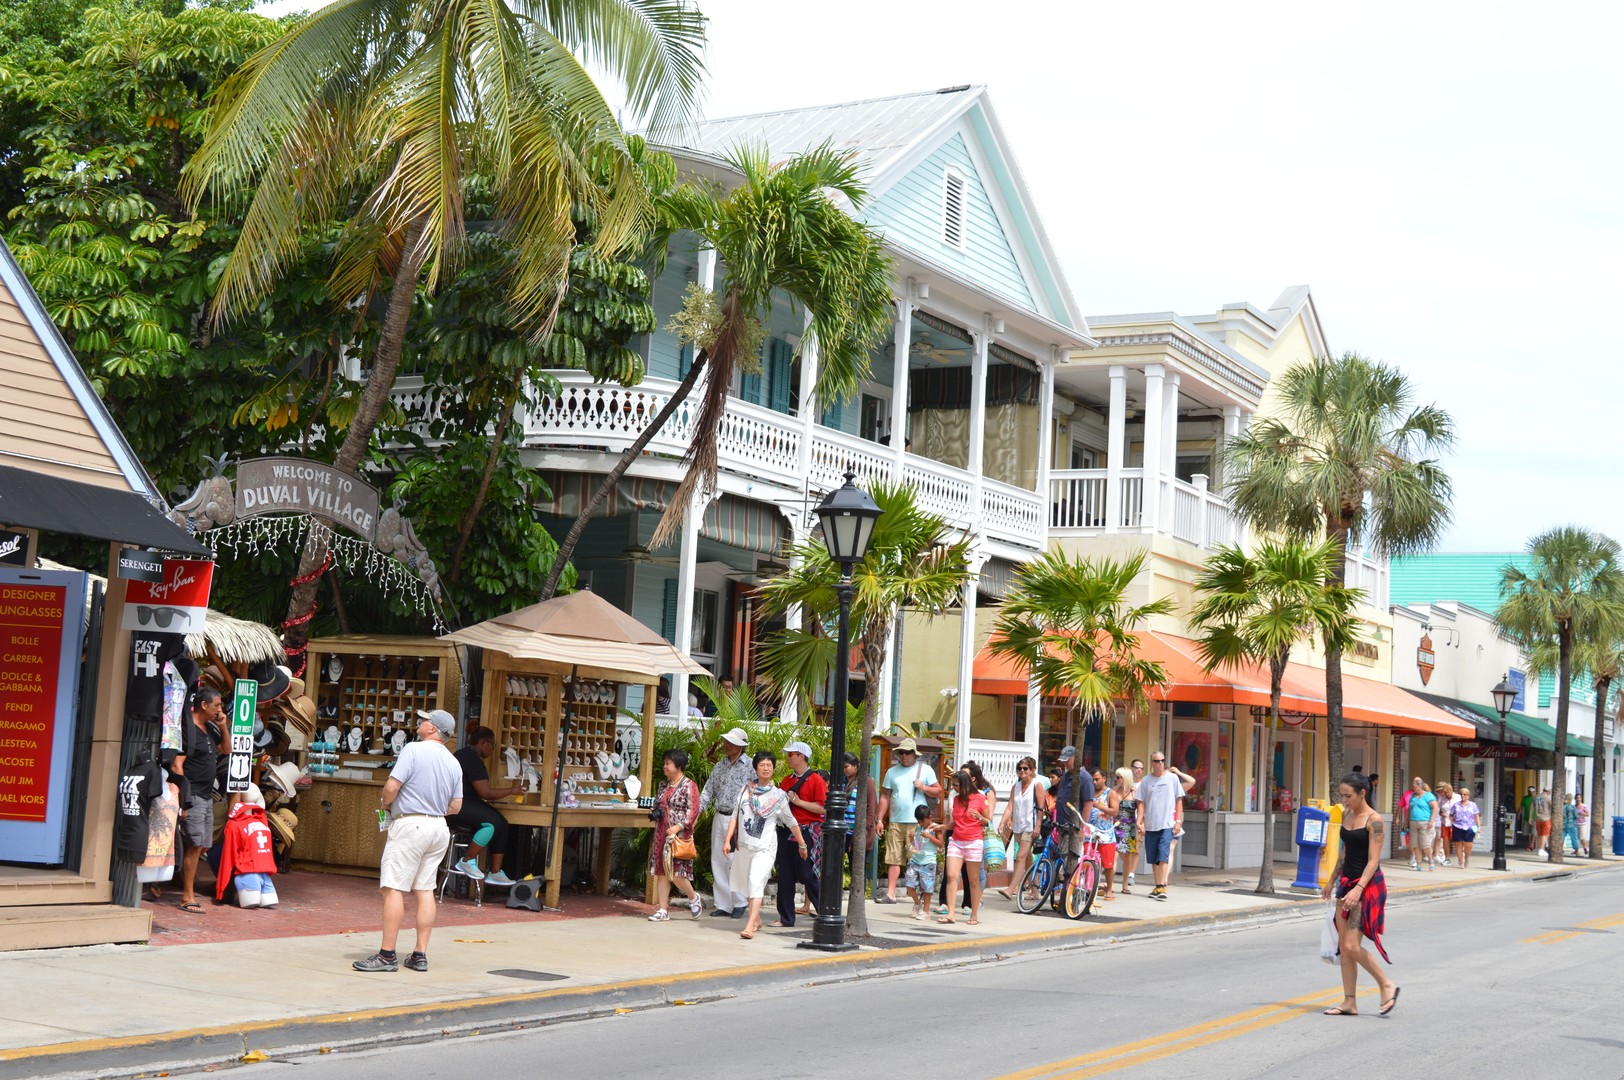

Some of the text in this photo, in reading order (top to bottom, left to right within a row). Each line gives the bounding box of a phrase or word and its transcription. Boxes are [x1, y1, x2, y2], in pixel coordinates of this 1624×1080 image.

[272, 465, 352, 493] WELCOME TO
[243, 485, 373, 532] DUVAL VILLAGE
[120, 558, 162, 573] SERENGETI
[2, 589, 56, 601] DESIGNER
[11, 636, 39, 646] BOLLE
[135, 640, 162, 655] EAST
[3, 653, 43, 664] CARRERA
[1, 671, 42, 682] DOLCE &
[0, 682, 43, 693] GABBANA
[238, 682, 255, 697] MILE
[5, 702, 33, 712] FENDI
[240, 699, 250, 722] 0
[234, 725, 252, 733] KEY WEST
[233, 736, 251, 751] END
[239, 759, 243, 776] 1
[18, 776, 34, 786] JIM
[20, 794, 45, 804] KORS
